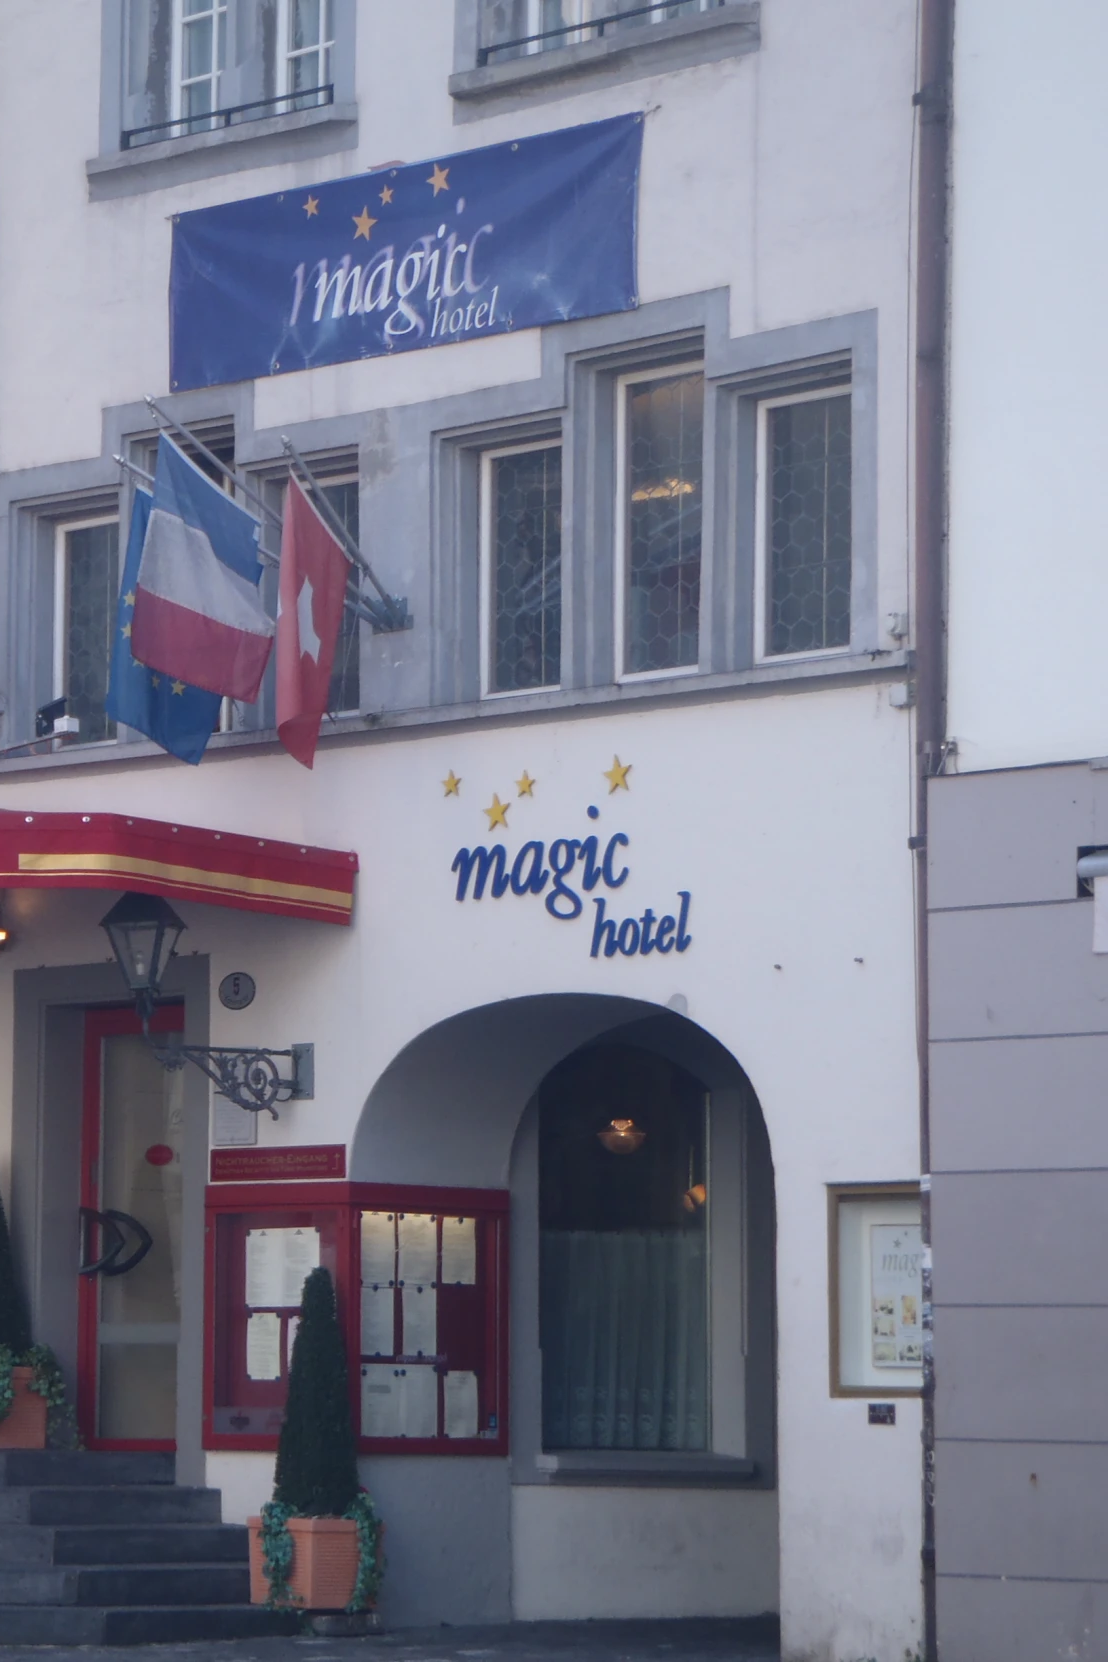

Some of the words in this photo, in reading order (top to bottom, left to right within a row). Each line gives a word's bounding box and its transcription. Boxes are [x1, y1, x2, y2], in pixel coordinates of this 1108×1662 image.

[312, 222, 469, 337] magic
[431, 286, 499, 338] hotel
[451, 805, 630, 921] magic
[590, 891, 692, 958] hotel
